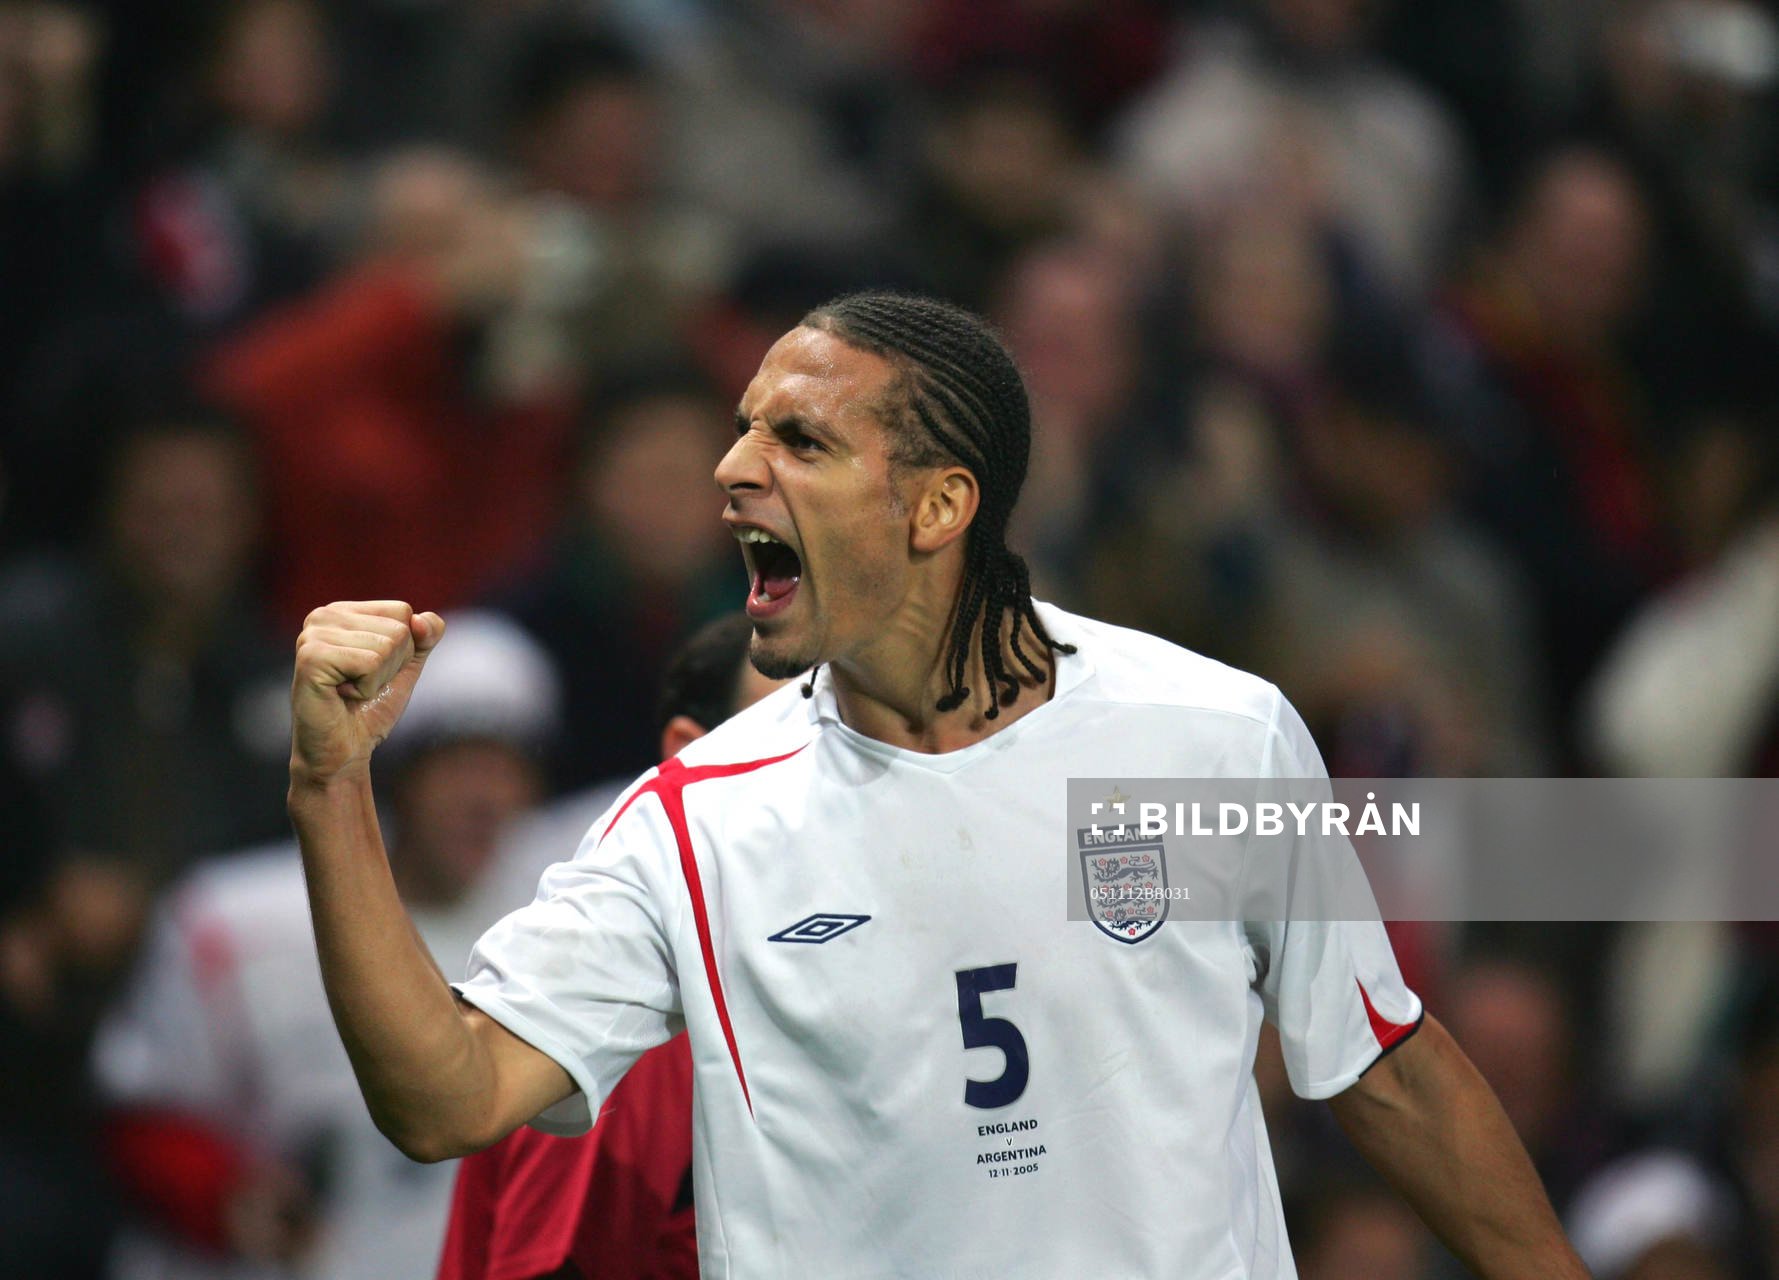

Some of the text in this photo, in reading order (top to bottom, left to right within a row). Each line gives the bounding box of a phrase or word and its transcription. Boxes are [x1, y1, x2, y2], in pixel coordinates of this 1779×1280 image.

[955, 963, 1029, 1109] 5
[977, 1119, 1038, 1137] ENGLAND
[976, 1144, 1047, 1165] ARGENTINA
